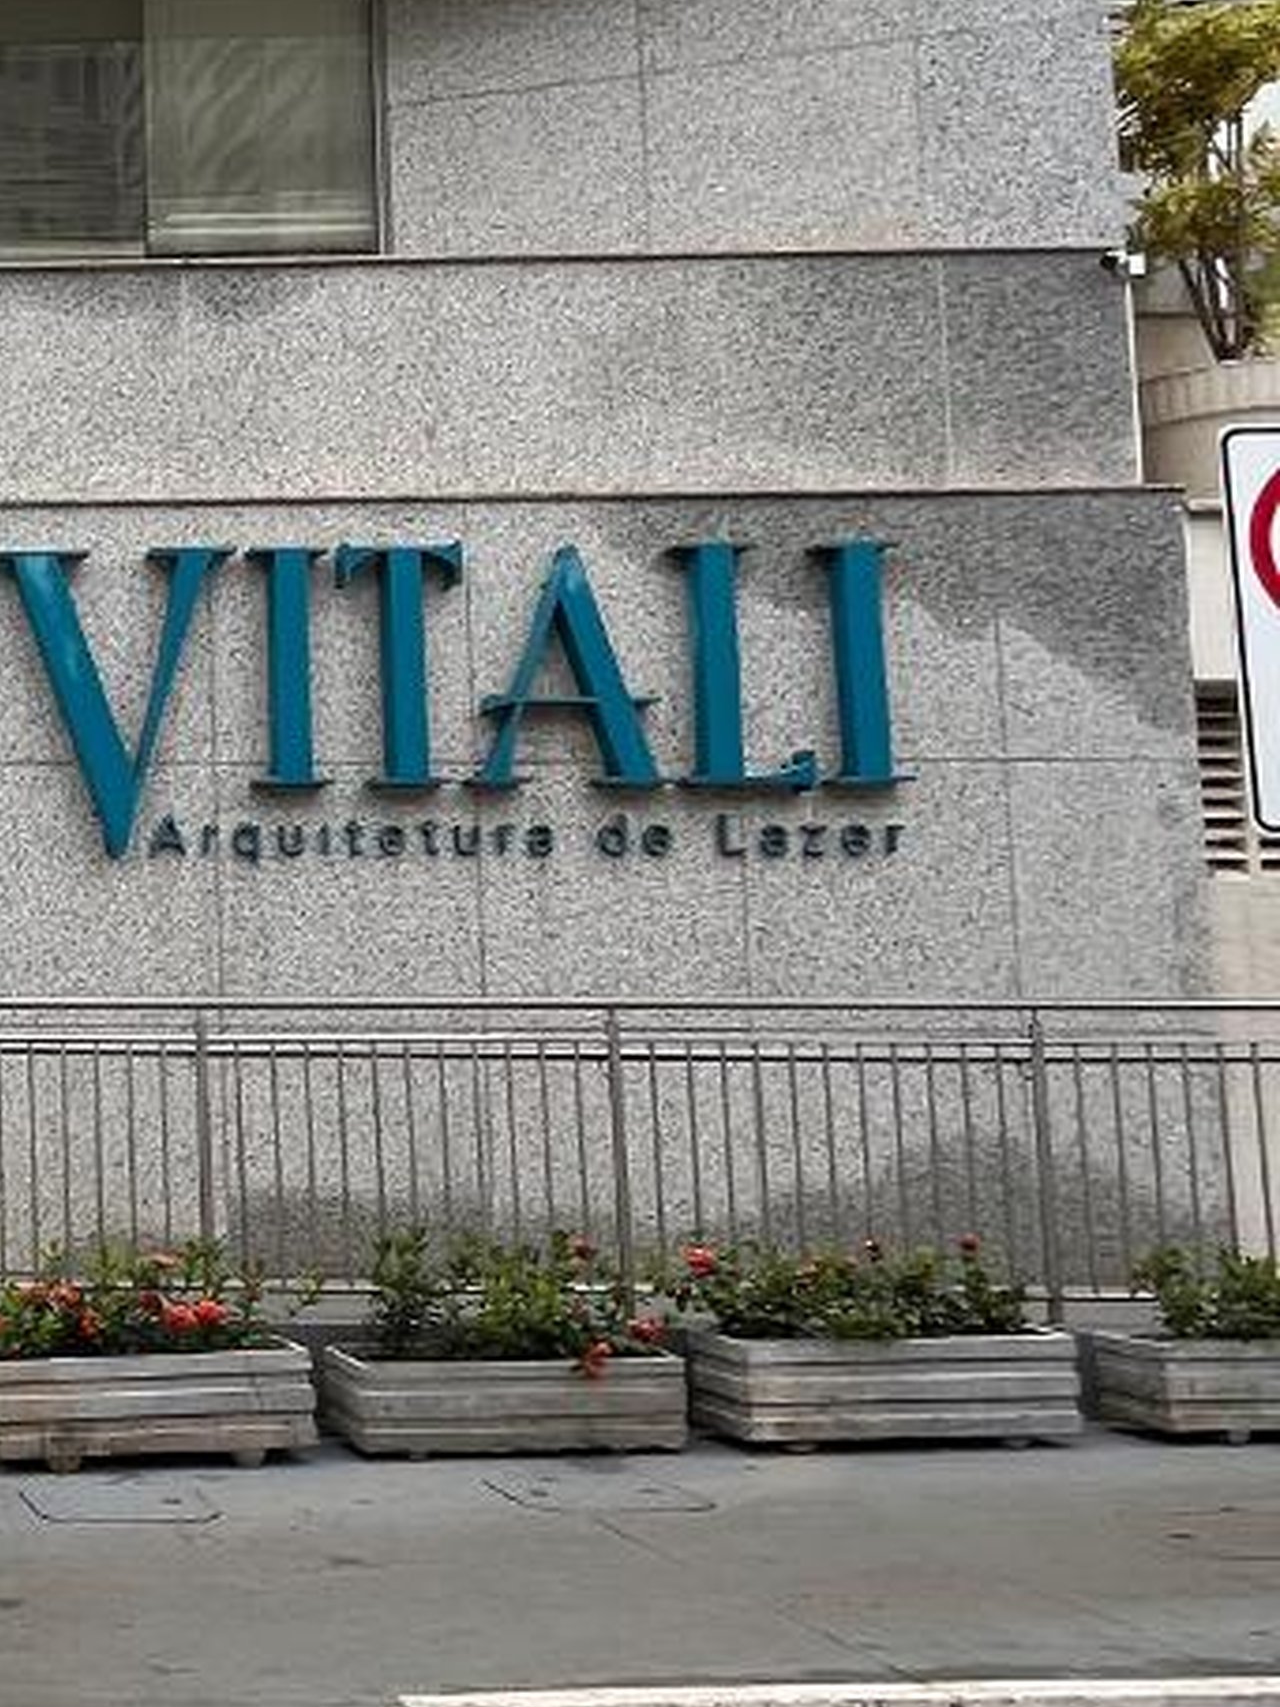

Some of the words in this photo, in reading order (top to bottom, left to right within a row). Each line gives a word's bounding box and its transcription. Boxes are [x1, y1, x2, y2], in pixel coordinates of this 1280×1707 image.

[148, 814, 554, 860] Arquitetura
[594, 811, 671, 857] de
[715, 811, 908, 859] Lazer
